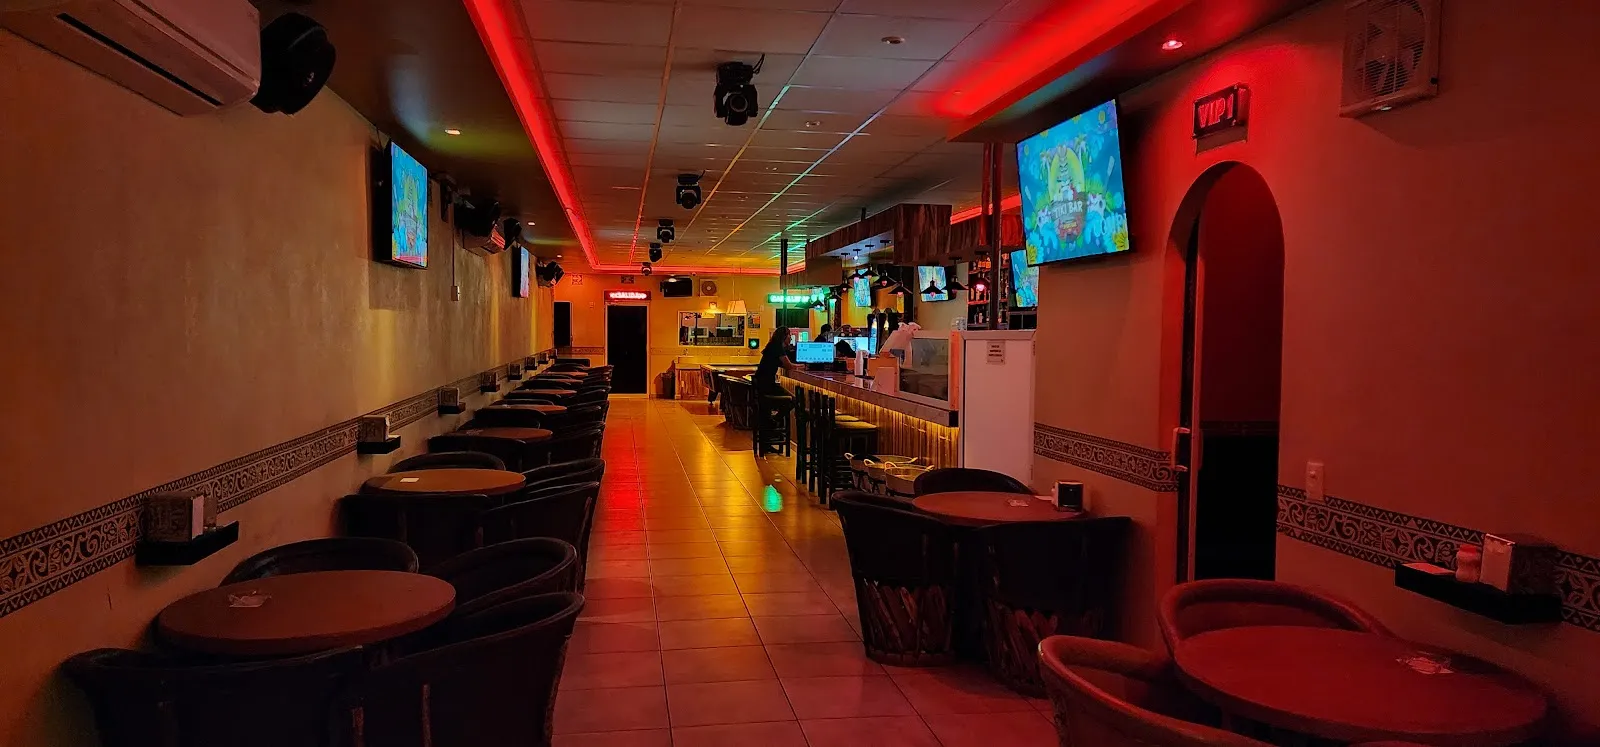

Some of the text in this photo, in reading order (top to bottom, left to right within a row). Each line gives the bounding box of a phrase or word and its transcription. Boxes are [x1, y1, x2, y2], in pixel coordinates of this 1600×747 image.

[1198, 98, 1225, 128] VIP
[1054, 201, 1083, 218] TIKI BAR
